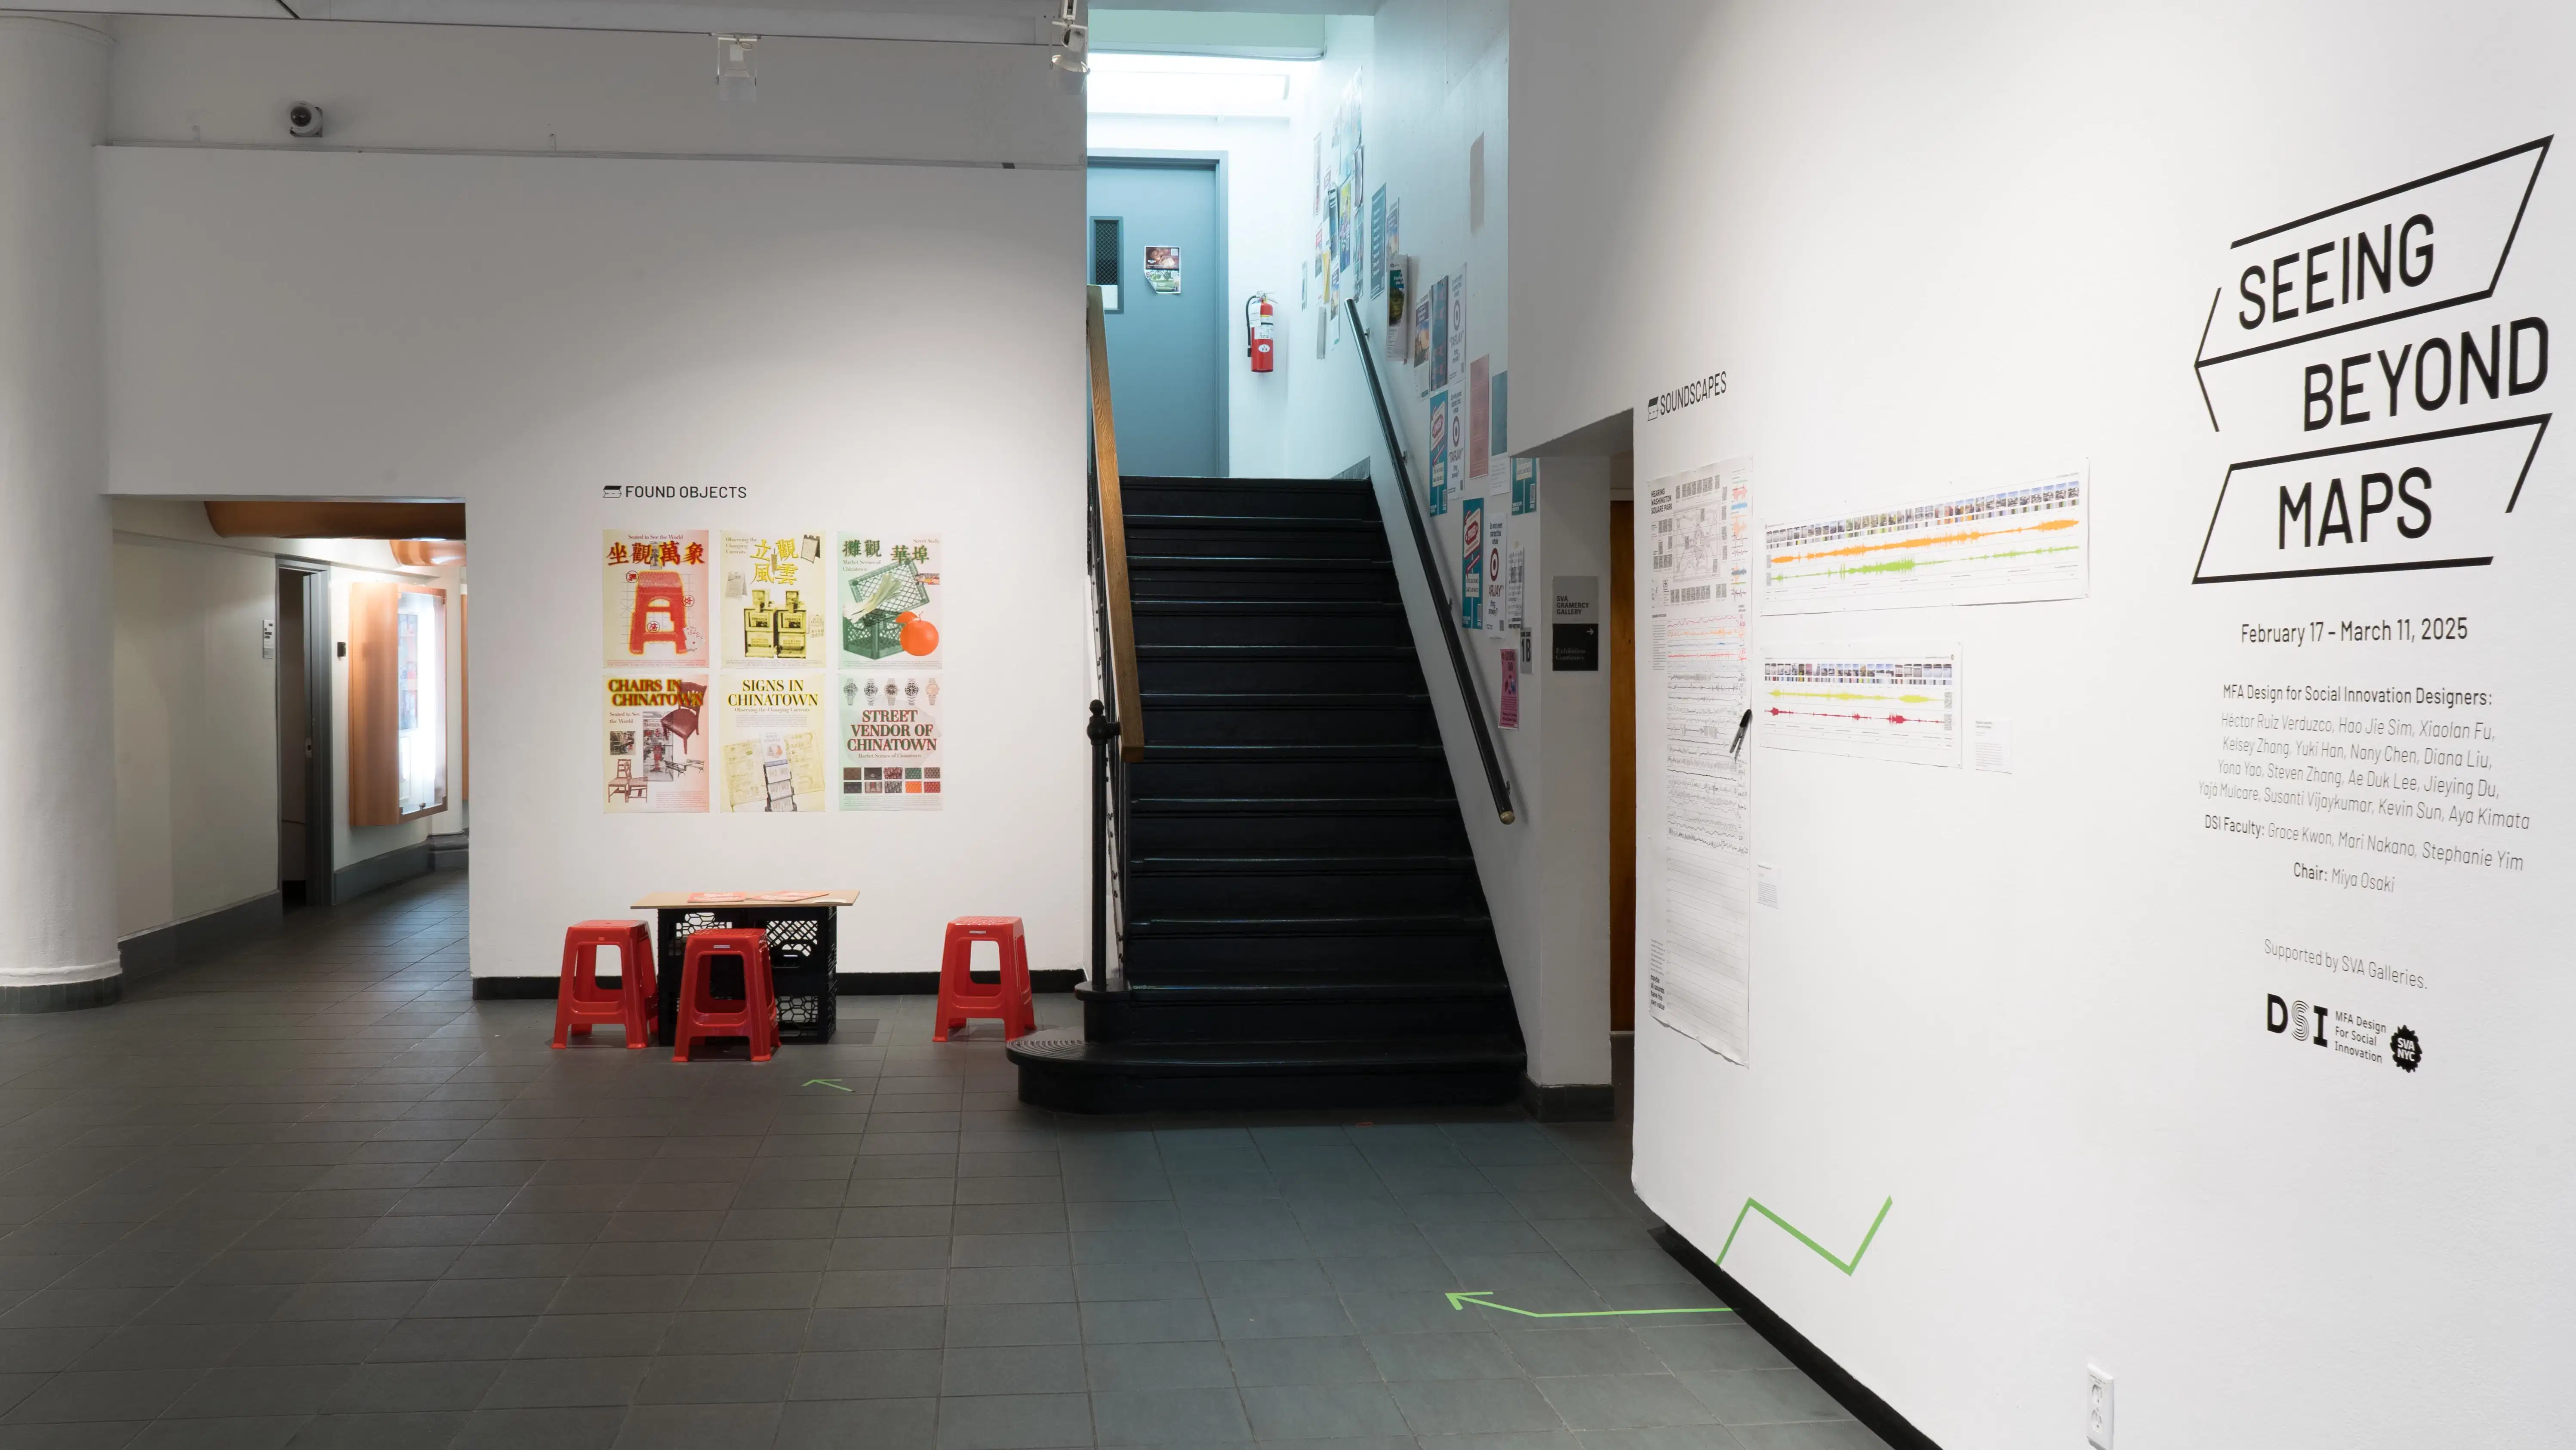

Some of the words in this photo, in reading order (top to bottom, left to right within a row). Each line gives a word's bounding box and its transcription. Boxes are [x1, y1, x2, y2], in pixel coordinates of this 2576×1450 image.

[2238, 213, 2434, 330] SEEING
[2304, 316, 2549, 432] BEYOND
[1660, 370, 1727, 415] SOUNDSCAPES
[625, 485, 676, 498] FOUND
[680, 485, 747, 498] OBJECTS
[1651, 488, 1665, 497] HEARING
[1651, 495, 1671, 505] WASHINGTON
[1651, 505, 1664, 514] SQUARE
[1664, 503, 1672, 511] PARK
[2279, 466, 2432, 549] MAPS
[606, 540, 705, 567] 坐觀萬象
[750, 538, 799, 561] 立觀
[749, 563, 799, 585] 風雲
[2241, 623, 2306, 648] February
[2310, 621, 2324, 642] 17
[2340, 620, 2391, 642] March
[2397, 619, 2416, 643] 11,
[2421, 617, 2468, 640] 2025
[608, 679, 663, 692] CHAIRS
[666, 679, 682, 692] IN
[742, 679, 784, 691] SIGNS
[788, 679, 803, 691] IN
[2223, 684, 2244, 699] MFA
[2247, 685, 2283, 703] Design
[2287, 685, 2302, 700] for
[2305, 685, 2340, 701] Social
[2345, 686, 2411, 703] Innovation
[2416, 687, 2492, 709] Designers:
[612, 693, 704, 706] CHINATOWN
[728, 694, 818, 706] CHINATOWN
[862, 710, 918, 722] STREET
[2221, 713, 2255, 728] Héctor
[2257, 714, 2279, 729] Ruiz
[2282, 715, 2335, 733] Verduzco,
[2339, 717, 2362, 734] Hao
[2365, 718, 2384, 734] Jie
[2388, 719, 2415, 737] Sim,
[2419, 719, 2470, 738] Xiaolan
[2474, 722, 2495, 742] Fu,
[851, 724, 911, 737] VENDOR
[914, 724, 933, 736] OF
[847, 738, 937, 751] CHINATOWN
[2223, 736, 2255, 756] Kelsey
[2257, 738, 2292, 758] Zhang,
[2296, 740, 2319, 756] Yuki
[2321, 742, 2347, 760] Han,
[2351, 744, 2381, 765] Nany
[2385, 745, 2420, 765] Chen,
[2424, 747, 2462, 766] Diana
[2467, 750, 2492, 769] Liu,
[2244, 761, 2265, 778] Yao,
[2267, 763, 2303, 780] Steven
[2306, 766, 2344, 787] Zhang,
[2348, 769, 2363, 786] Ae
[2367, 771, 2389, 788] Duk
[2394, 773, 2420, 792] Lee,
[2424, 775, 2473, 799] Jieying
[2478, 779, 2499, 799] Du,
[2220, 783, 2261, 802] Mulcare,
[2264, 787, 2304, 805] Susanti
[2307, 791, 2374, 814] Vijaykumar,
[2379, 798, 2413, 817] Kevin
[2416, 802, 2444, 822] Sun,
[2448, 805, 2474, 827] Aya
[2477, 807, 2530, 829] Kimata
[2205, 814, 2221, 830] DSI
[2224, 817, 2264, 839] Faculty:
[2268, 823, 2299, 840] Grace
[2302, 827, 2334, 847] Kwon,
[2338, 831, 2364, 850] Mari
[2367, 834, 2417, 858] Nakano,
[2422, 842, 2493, 865] Stephanie
[2497, 850, 2524, 871] Yim
[2294, 862, 2327, 881] Chair:
[2332, 868, 2357, 889] Miya
[2361, 872, 2395, 893] Osaki
[2264, 939, 2322, 966] Supported
[2325, 951, 2339, 973] by
[2342, 956, 2365, 976] SVA
[2369, 961, 2428, 989] Galleries.
[2267, 993, 2328, 1048] DSI
[2336, 1010, 2354, 1024] MFA
[2356, 1015, 2386, 1034] Design
[2336, 1026, 2349, 1038] For
[2351, 1030, 2376, 1046] Social
[2397, 1037, 2415, 1051] SVA
[2335, 1040, 2382, 1064] Innovation
[2397, 1048, 2415, 1062] NYC
